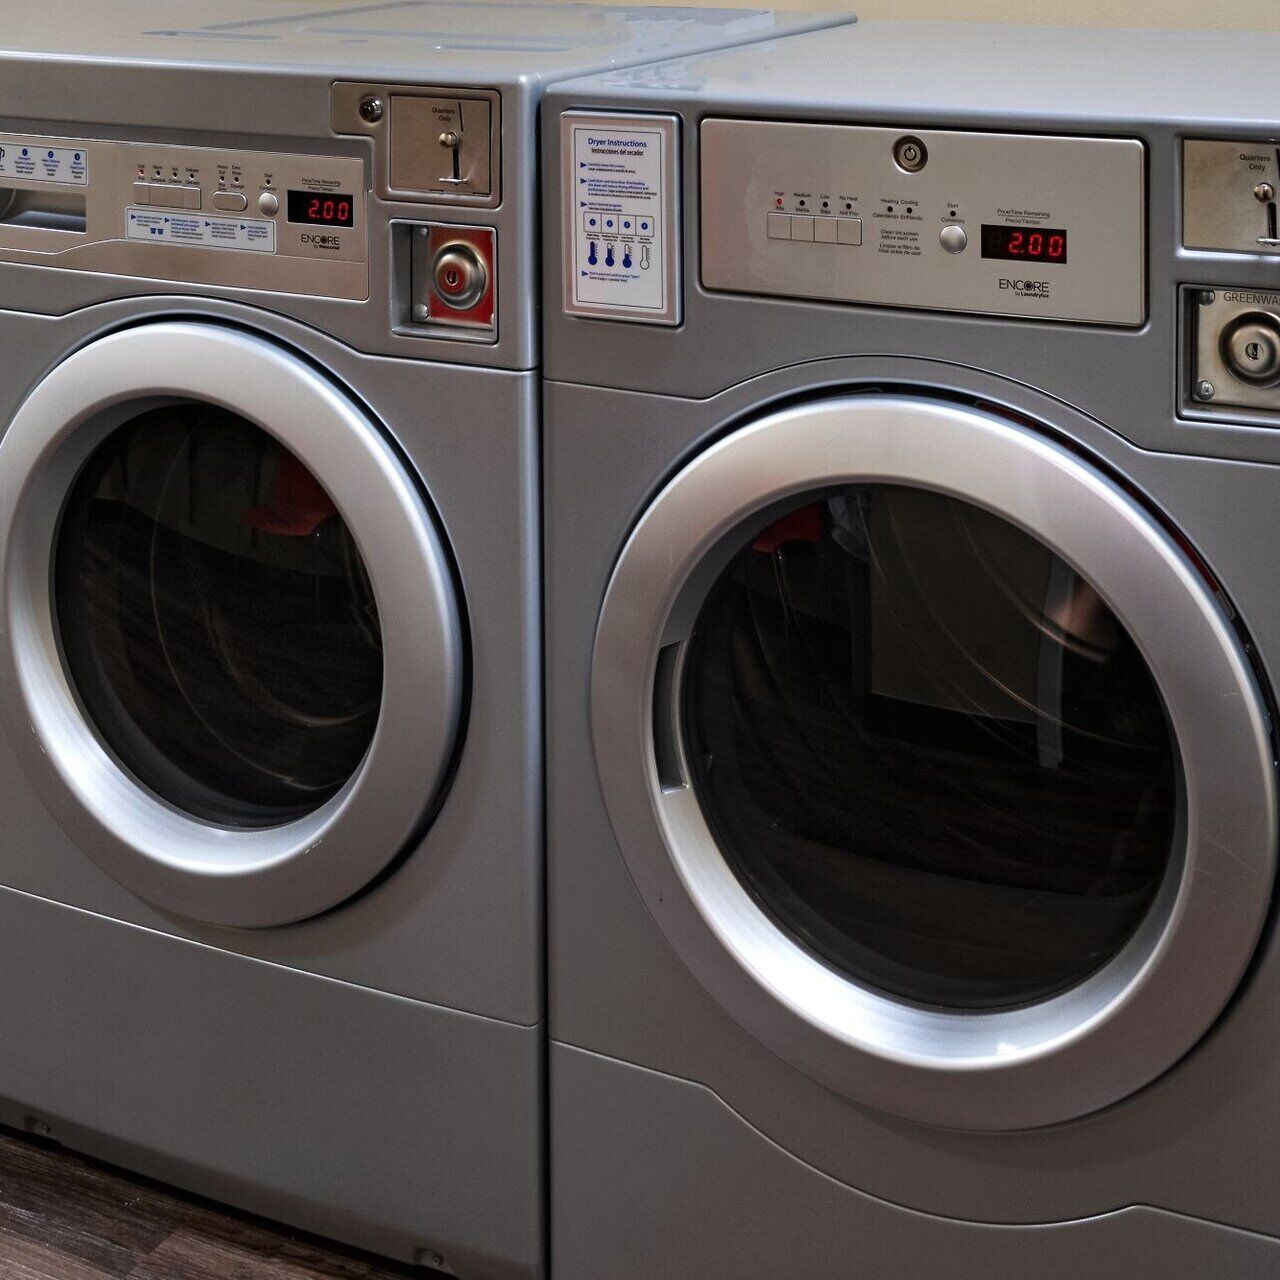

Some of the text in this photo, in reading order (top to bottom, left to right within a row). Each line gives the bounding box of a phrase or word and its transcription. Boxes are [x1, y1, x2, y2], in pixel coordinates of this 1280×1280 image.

[588, 137, 647, 148] Dryer Instructions
[1239, 153, 1272, 162] Quarters
[1248, 163, 1266, 172] Only
[309, 200, 349, 220] 2.00
[301, 234, 340, 246] ENCORE
[1008, 233, 1063, 257] 2.00
[998, 278, 1050, 293] ENCORE
